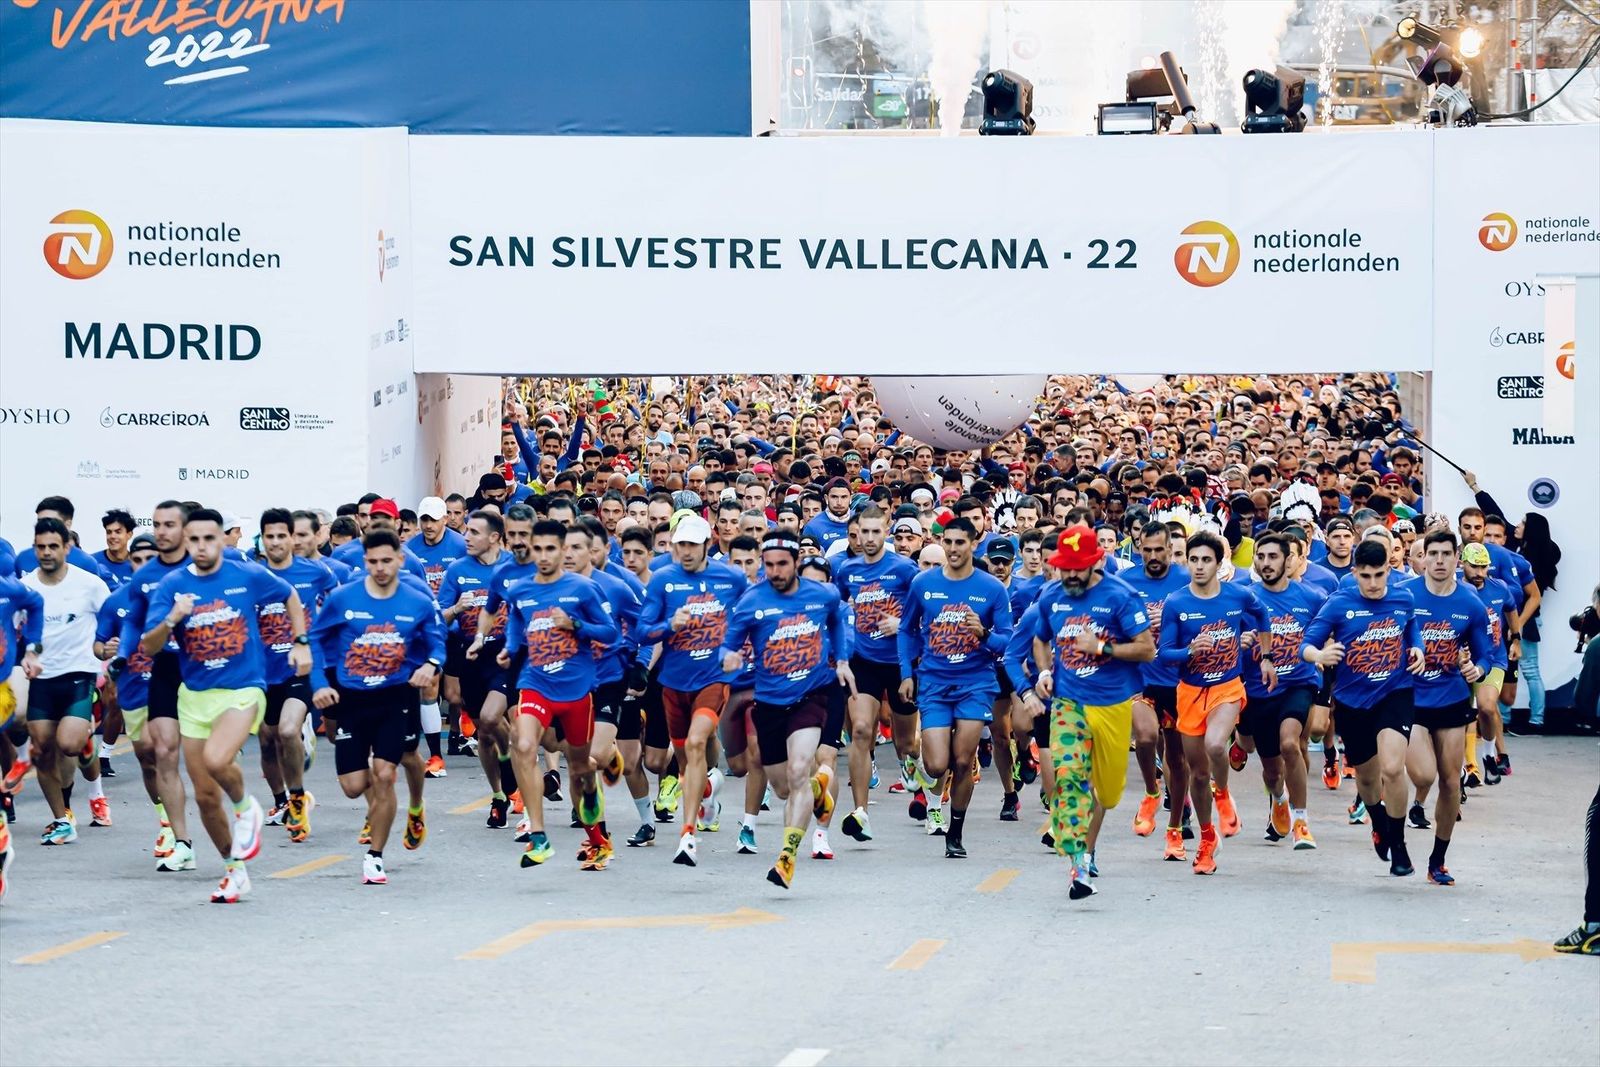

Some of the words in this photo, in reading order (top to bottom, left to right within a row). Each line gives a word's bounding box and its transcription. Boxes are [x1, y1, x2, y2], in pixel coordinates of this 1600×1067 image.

[145, 28, 271, 68] 2022
[128, 221, 241, 243] nationale
[1525, 216, 1590, 229] nationale
[1253, 228, 1362, 249] nationale
[128, 246, 281, 269] nederlanden
[448, 235, 534, 268] SAN
[551, 236, 782, 269] SILVESTRE
[799, 238, 1049, 270] VALLECANA
[1087, 238, 1138, 269] 22
[1253, 252, 1400, 273] nederlanden
[1504, 280, 1546, 298] OYS
[64, 321, 262, 362] MADRID
[1500, 377, 1527, 388] SANI
[1499, 387, 1544, 398] CENTRO
[242, 408, 270, 419] SANI
[241, 419, 289, 430] CENTRO
[196, 468, 250, 480] MADRID
